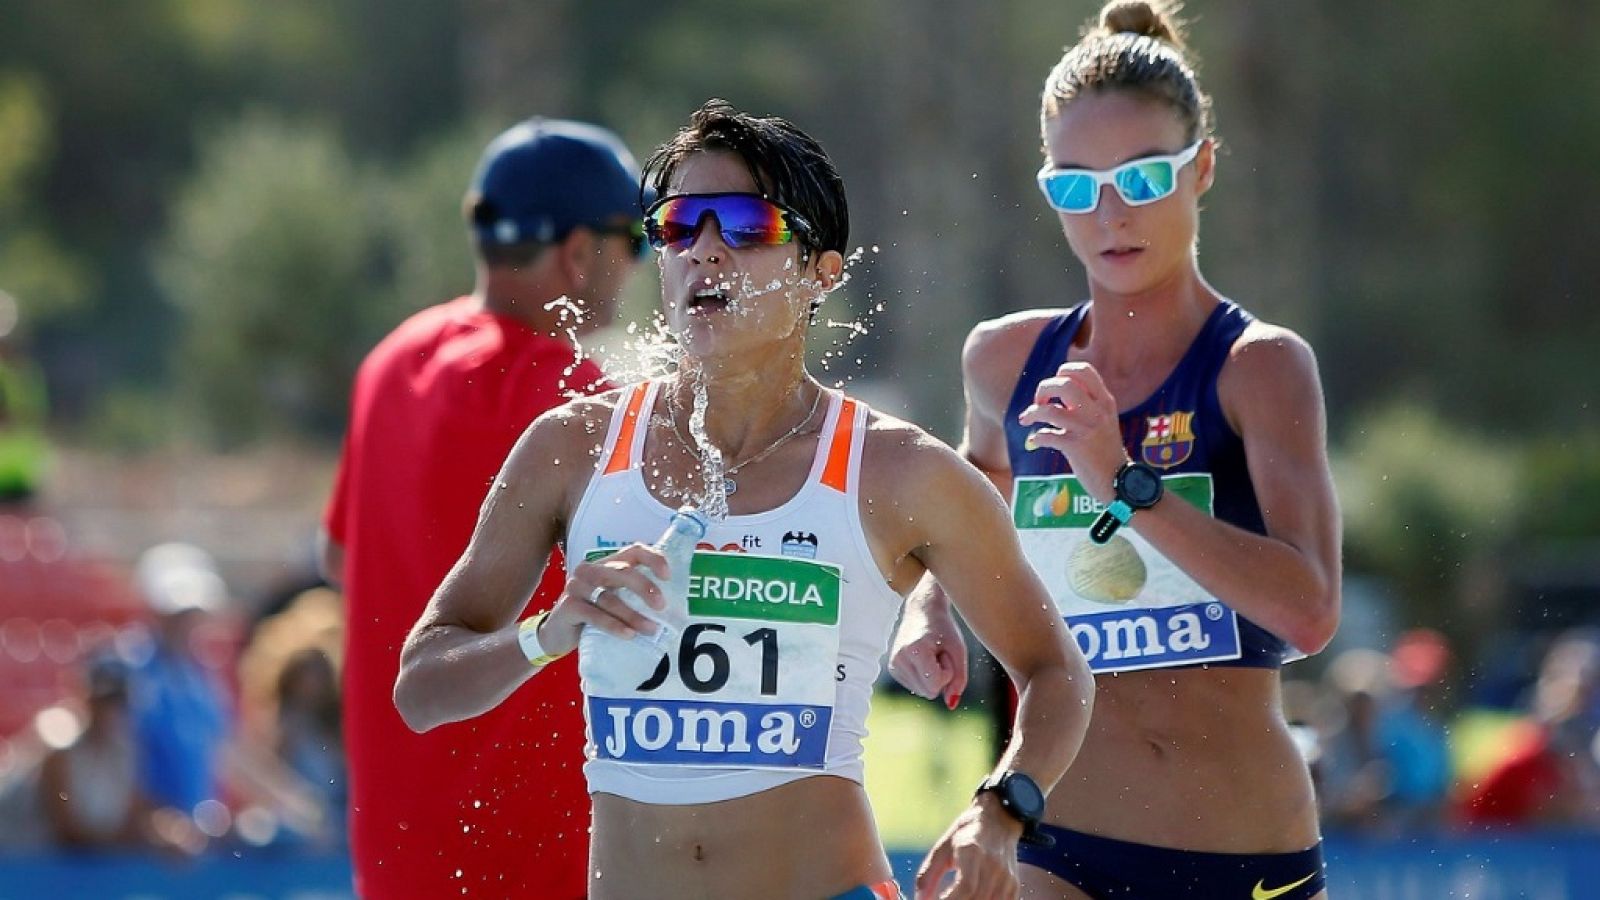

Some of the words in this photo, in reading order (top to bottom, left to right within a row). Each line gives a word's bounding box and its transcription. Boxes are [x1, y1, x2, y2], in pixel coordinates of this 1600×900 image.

[1073, 495, 1104, 514] IBE
[742, 534, 762, 548] fit
[687, 575, 824, 607] ERDROLA
